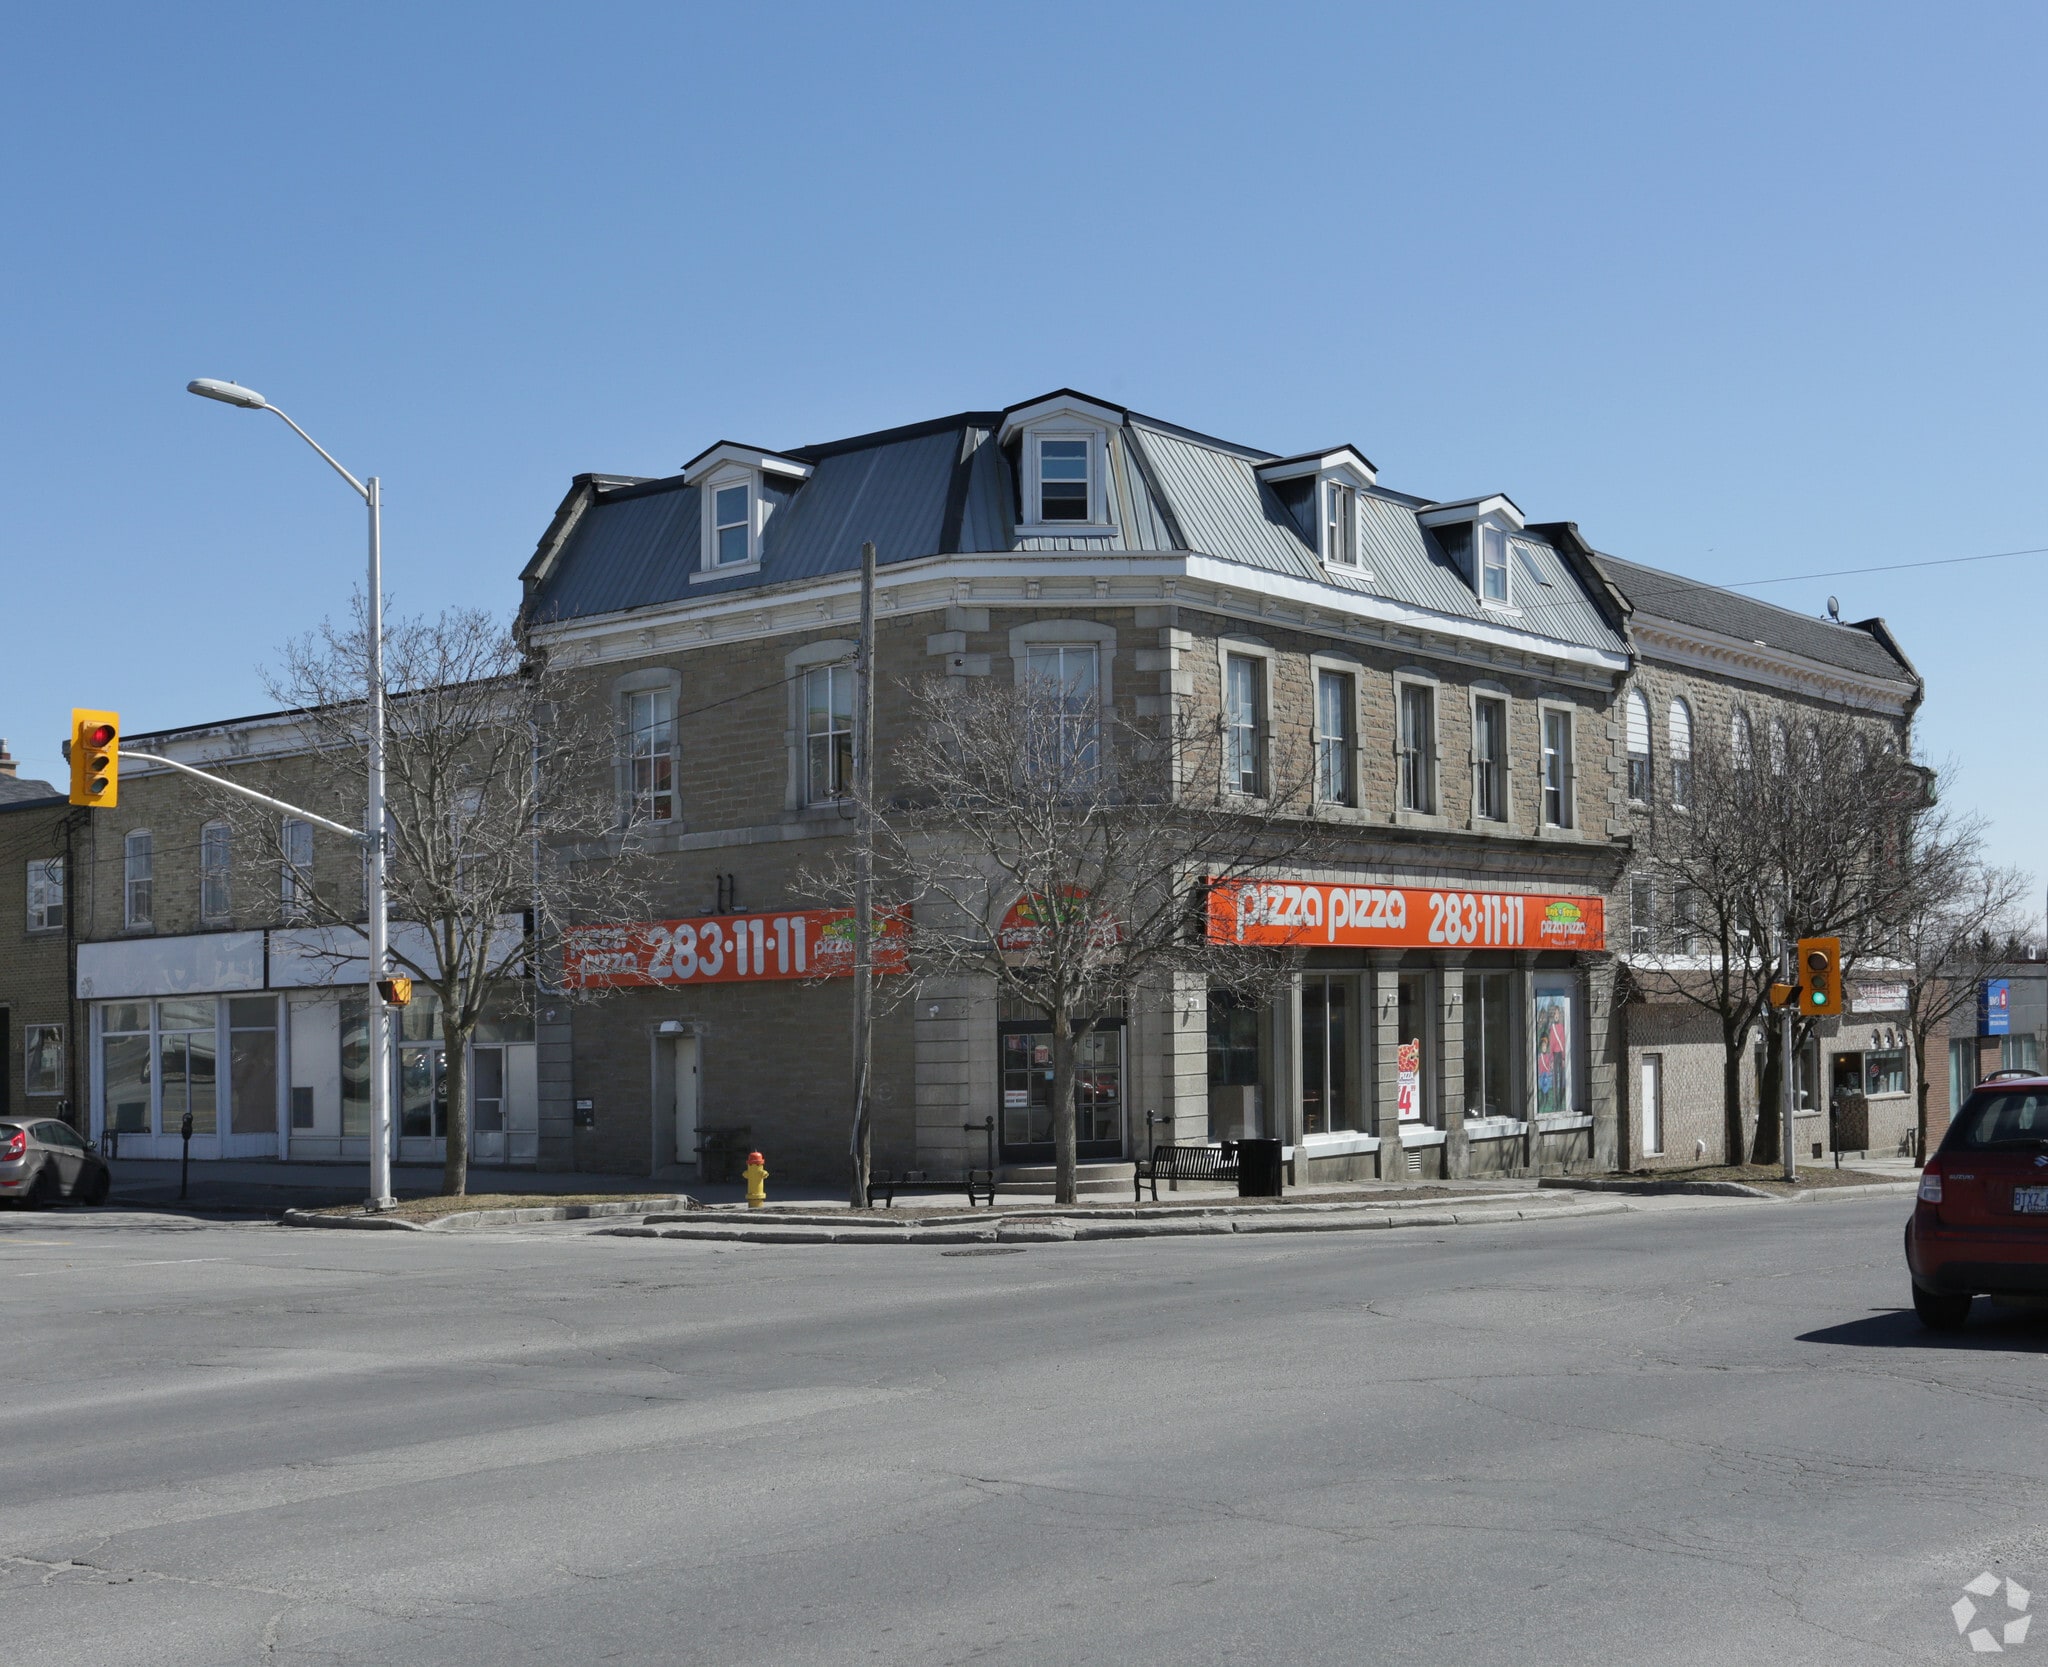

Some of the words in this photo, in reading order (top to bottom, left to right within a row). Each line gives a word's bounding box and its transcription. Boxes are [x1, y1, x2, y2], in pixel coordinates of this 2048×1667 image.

[1237, 884, 1323, 941] pizza
[1328, 888, 1406, 942] pizza
[1540, 920, 1564, 938] pizza
